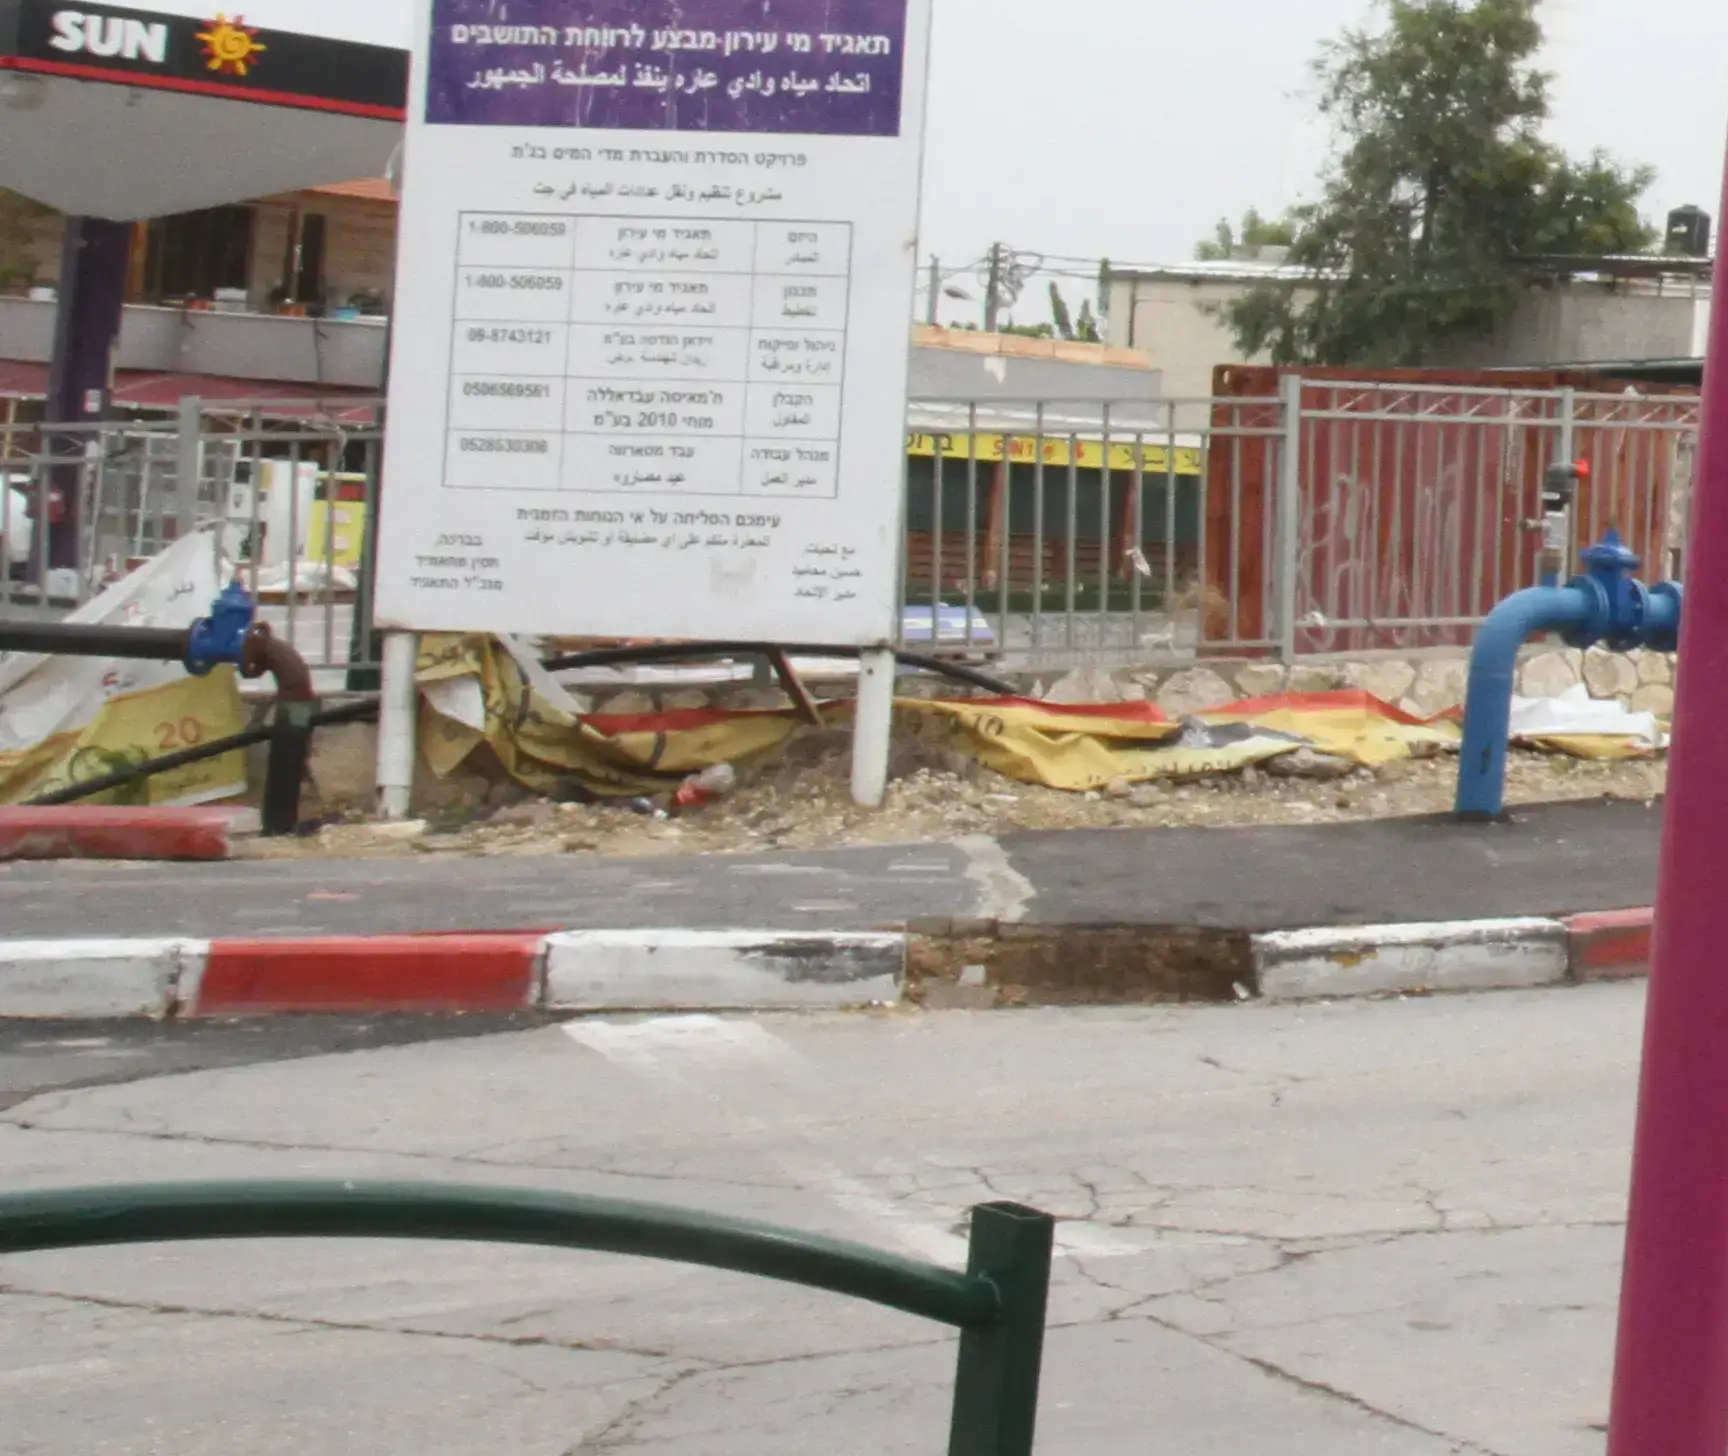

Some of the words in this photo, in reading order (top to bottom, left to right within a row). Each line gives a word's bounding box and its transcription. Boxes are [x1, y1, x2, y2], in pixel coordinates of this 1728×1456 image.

[49, 9, 168, 64] SUN
[451, 24, 558, 46] התושבים
[564, 23, 645, 48] לרווחת
[786, 32, 811, 53] מי
[819, 33, 890, 55] תאגיד
[465, 62, 546, 90] الجمهور
[550, 59, 626, 87] لمصلحة
[726, 69, 776, 98] وادي
[780, 70, 819, 96] مياه
[824, 70, 871, 93] اتحاد
[553, 147, 591, 161] המים
[593, 410, 632, 427] בע"מ
[638, 411, 678, 427] 2010
[629, 511, 645, 524] אי
[649, 505, 668, 525] על
[672, 508, 730, 525] הסליחה
[152, 714, 201, 750] 20
